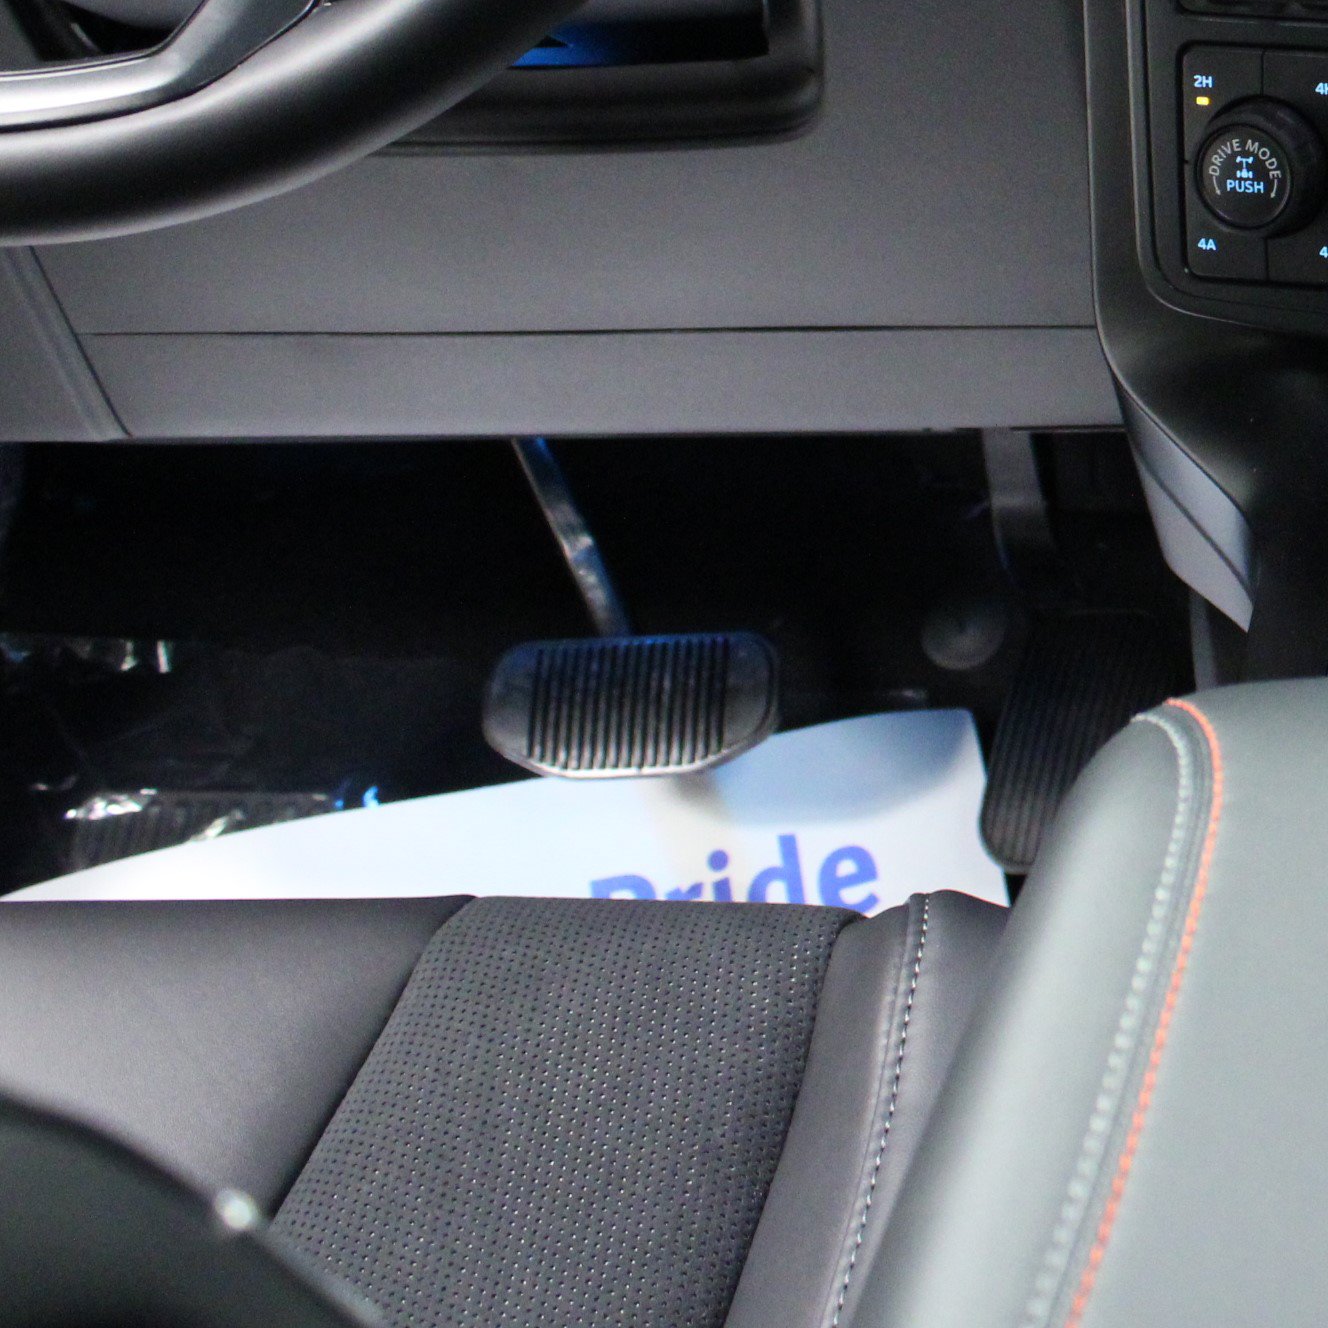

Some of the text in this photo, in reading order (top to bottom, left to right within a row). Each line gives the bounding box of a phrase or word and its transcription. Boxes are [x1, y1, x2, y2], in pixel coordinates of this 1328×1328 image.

[1193, 75, 1213, 89] 2H
[1208, 138, 1282, 180] DRIVE MODE
[1226, 179, 1265, 194] PUSH
[1197, 238, 1217, 252] 4A
[590, 832, 880, 919] ide
